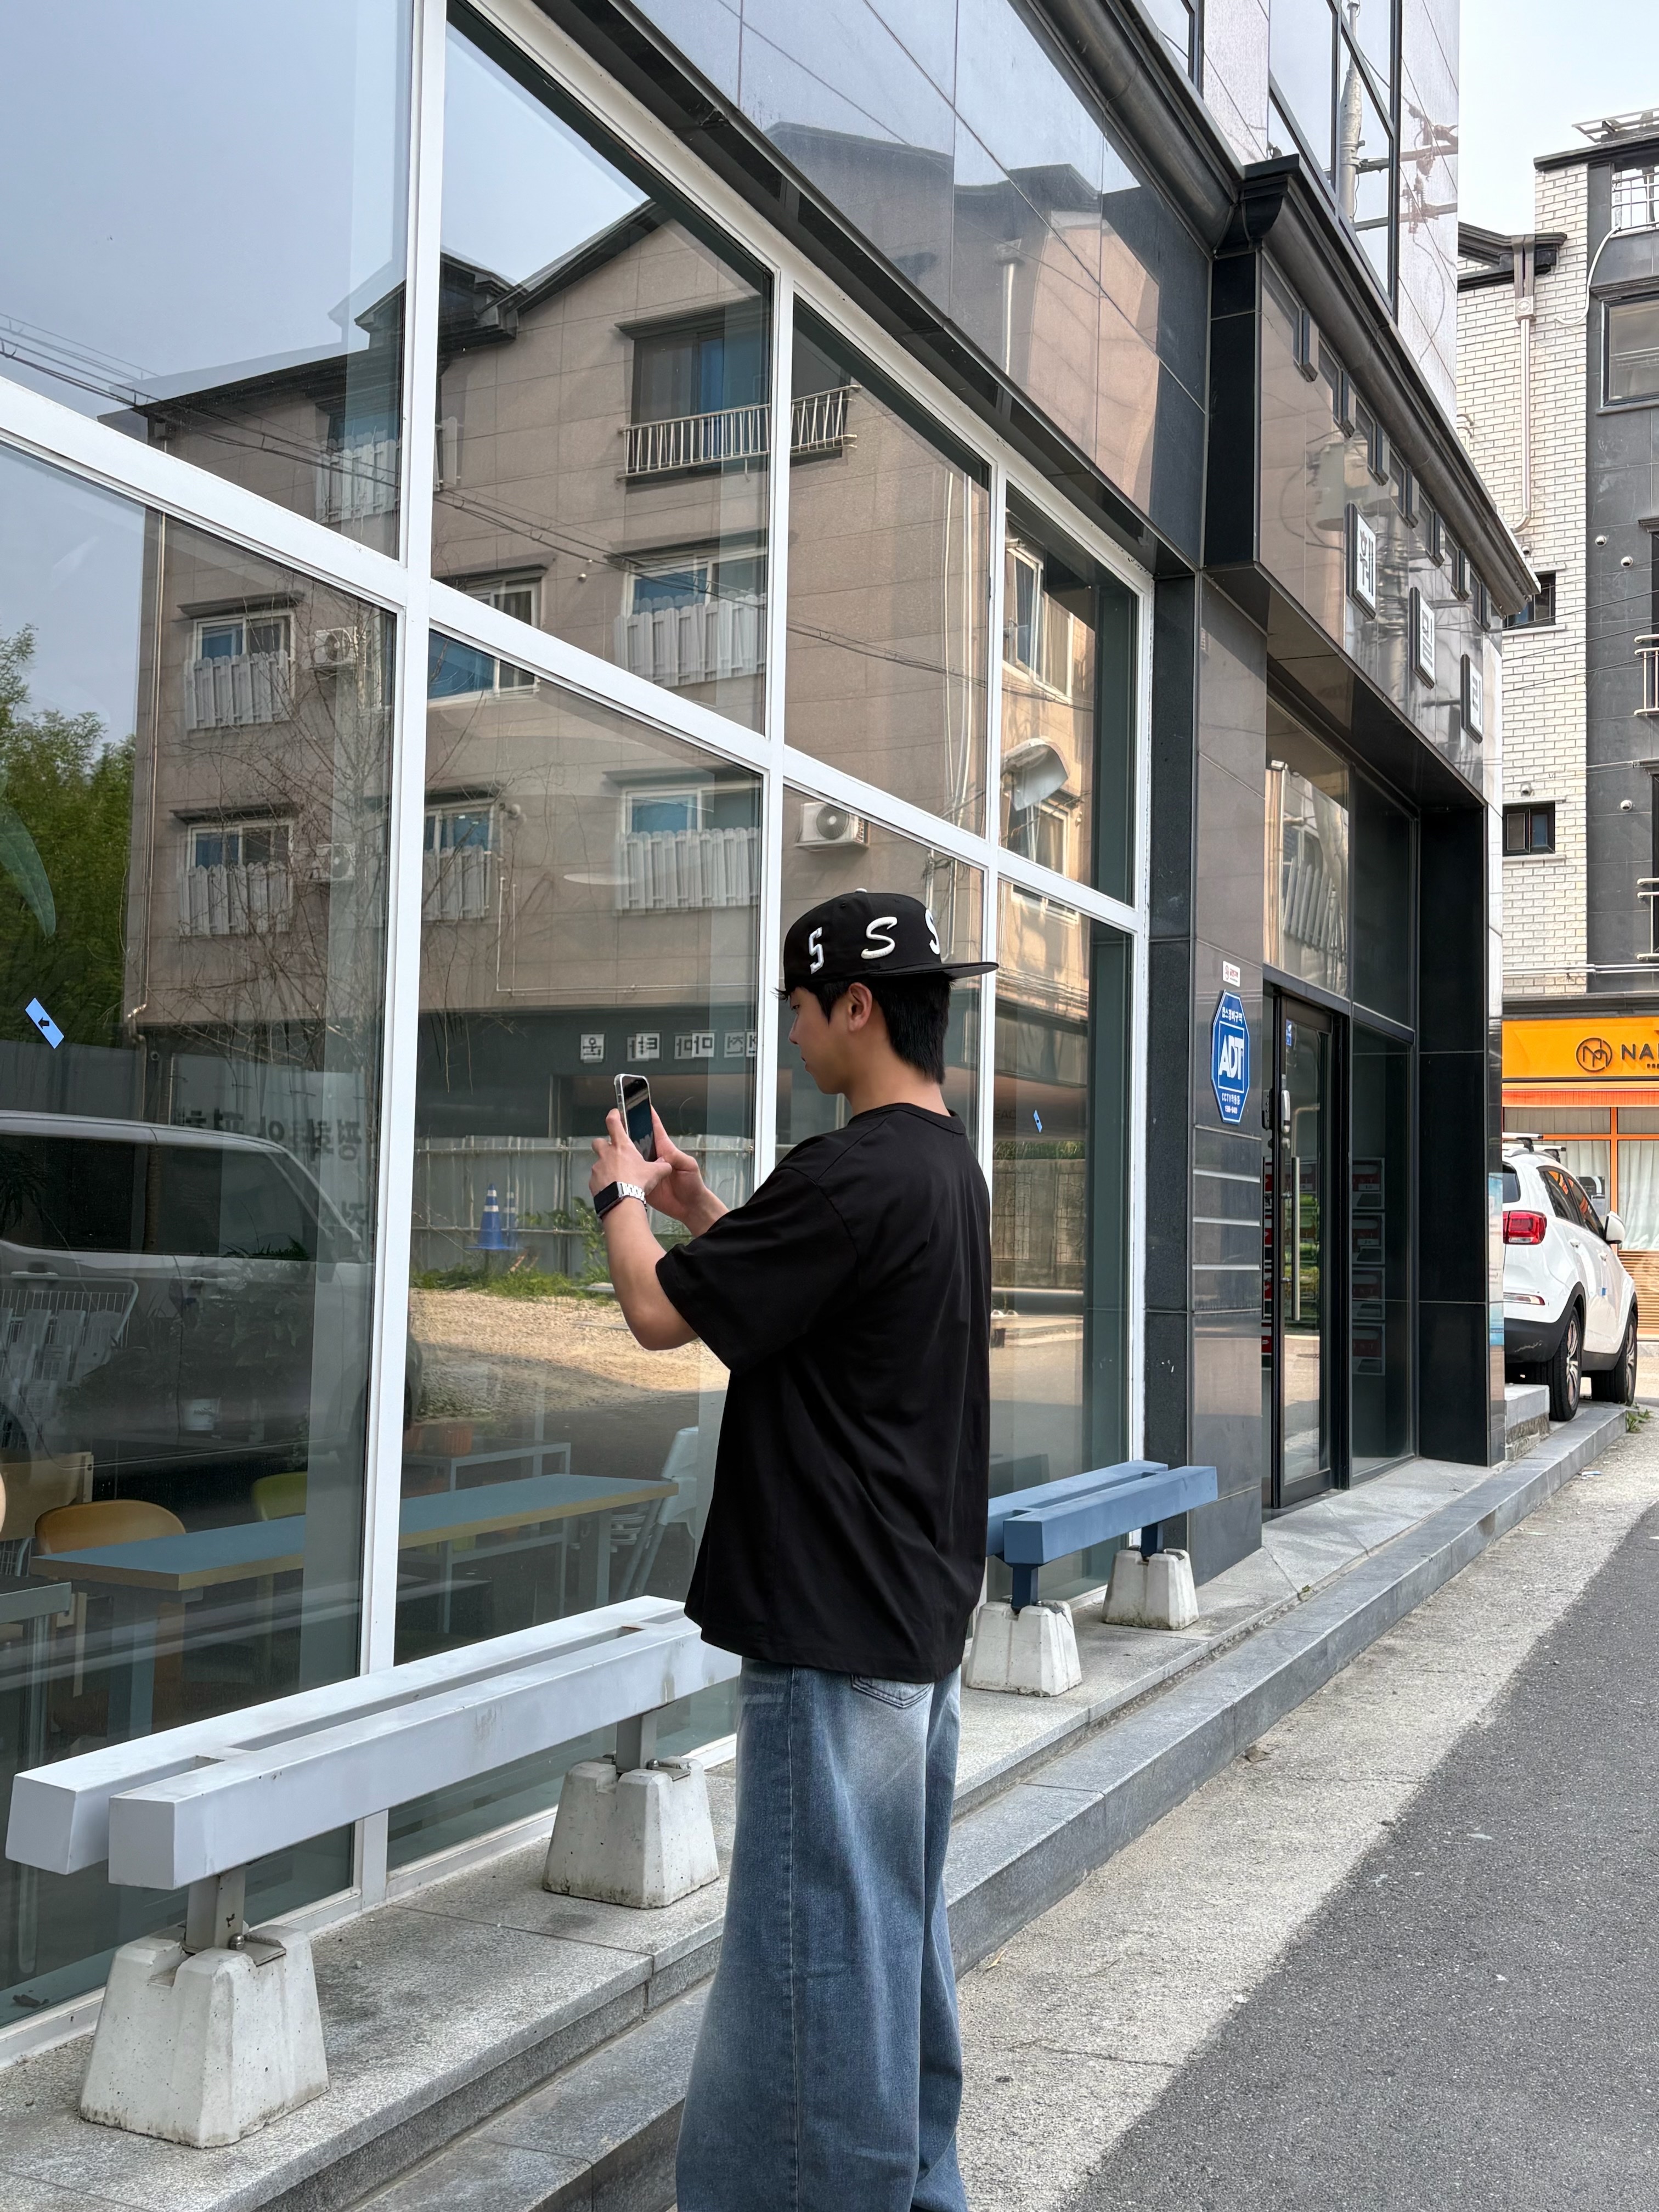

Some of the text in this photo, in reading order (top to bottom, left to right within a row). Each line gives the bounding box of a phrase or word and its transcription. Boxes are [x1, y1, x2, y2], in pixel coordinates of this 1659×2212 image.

[809, 927, 823, 974] S
[861, 916, 898, 959] S
[1219, 1035, 1244, 1080] ADT
[1621, 1043, 1659, 1060] NA
